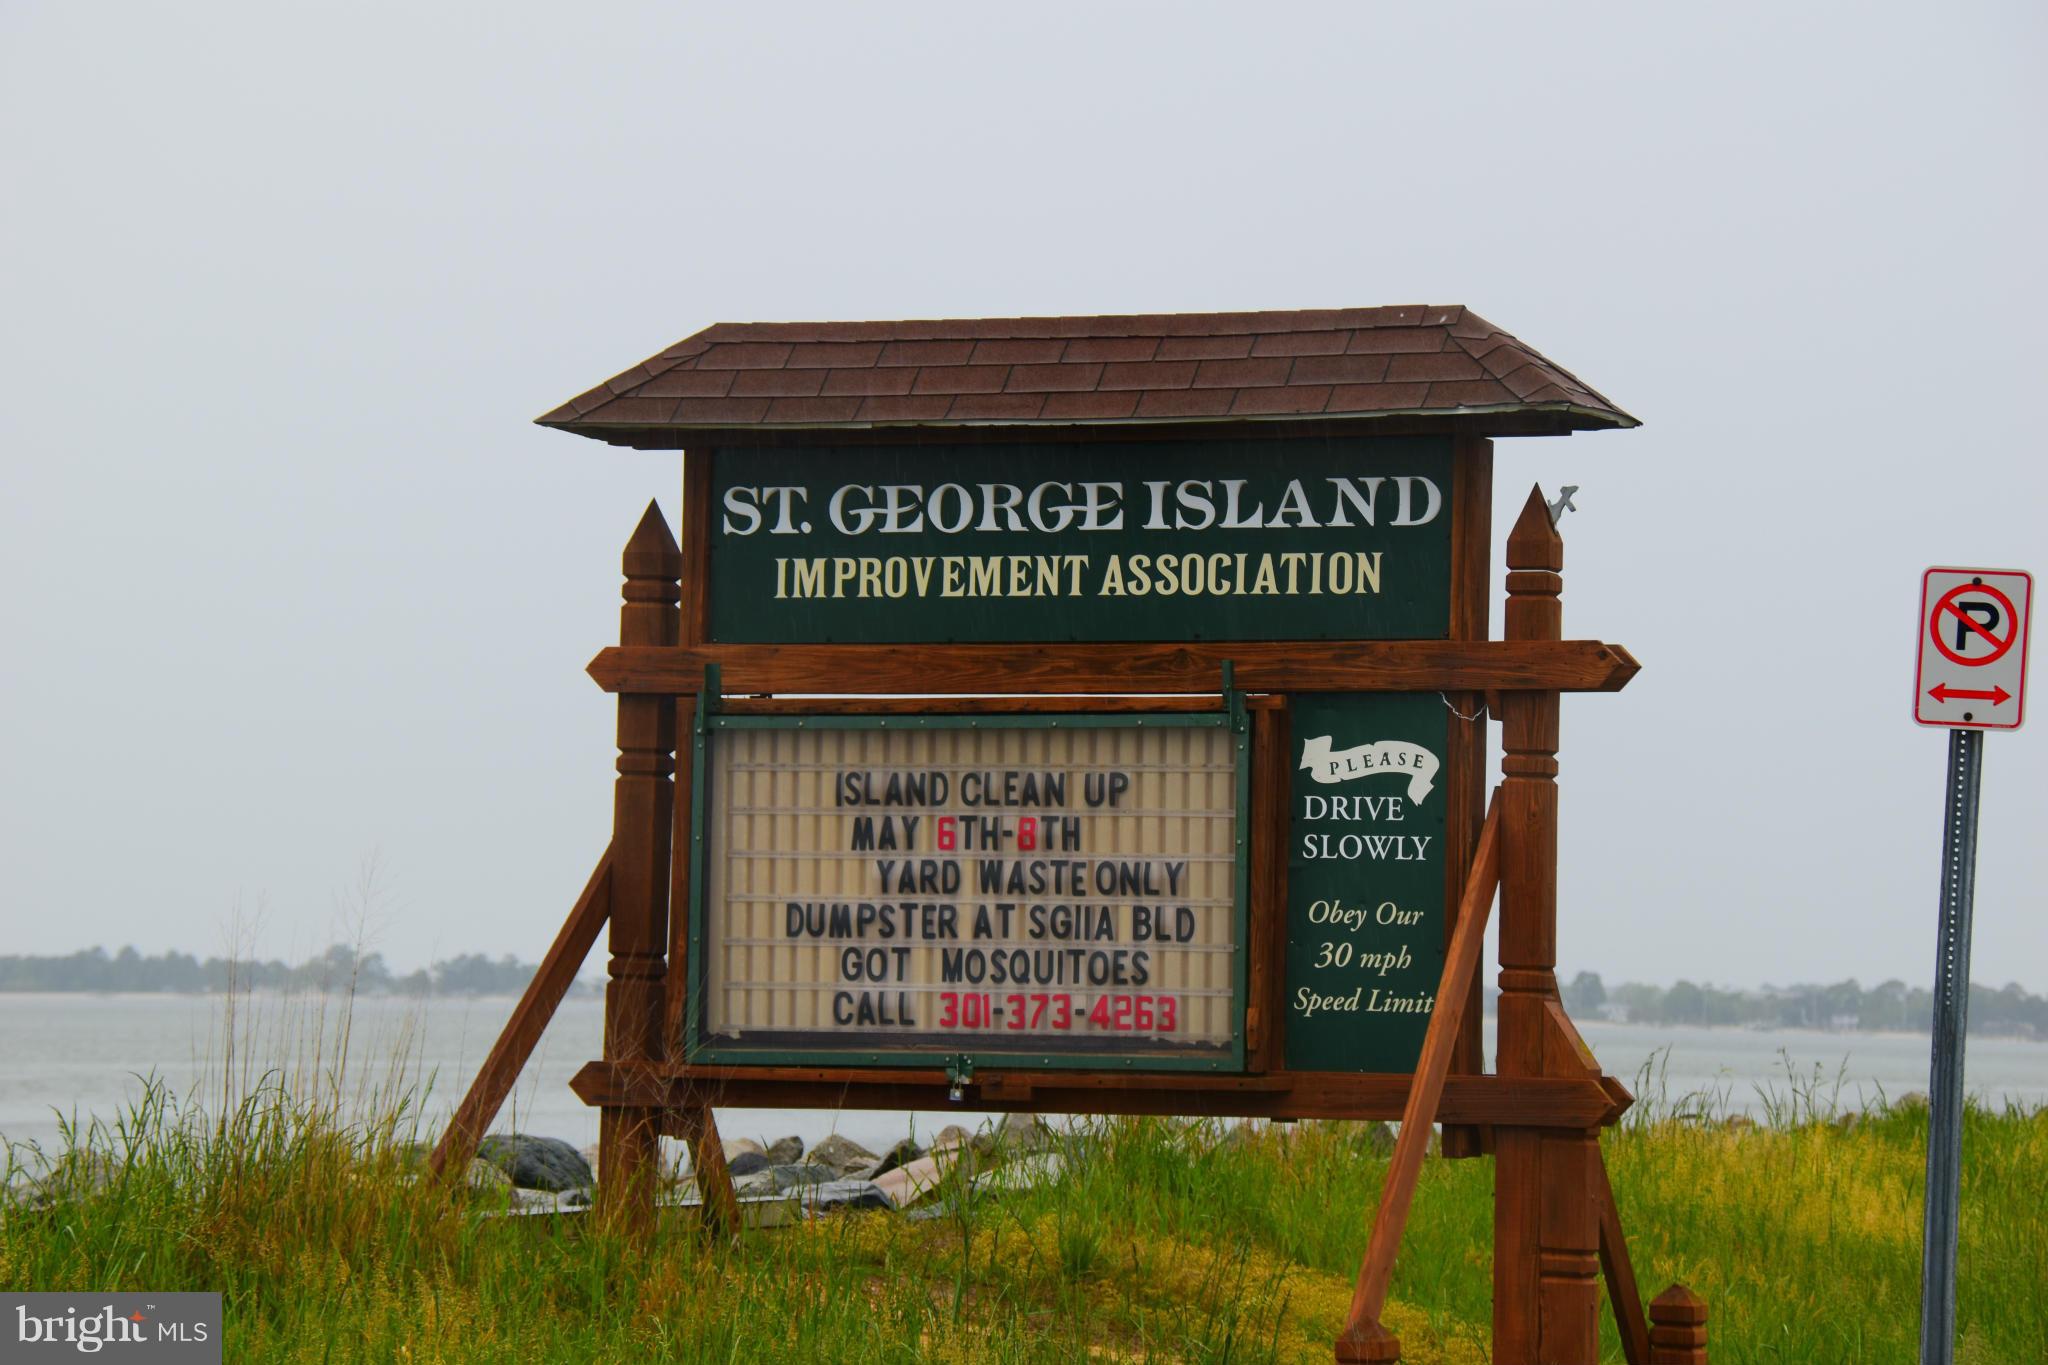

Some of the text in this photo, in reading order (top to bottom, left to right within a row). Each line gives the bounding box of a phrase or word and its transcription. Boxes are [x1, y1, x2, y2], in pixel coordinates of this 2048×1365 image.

[723, 475, 1443, 536] ST. GEORGE ISLAND
[774, 551, 1384, 601] IMPROVEMENT ASSOCIATION
[1956, 601, 2000, 651] P
[1329, 751, 1424, 776] PLEASE
[835, 771, 1129, 807] ISLAND CLEAN UP
[1303, 795, 1405, 822] DRIVE
[851, 816, 1080, 851] MAY 6TH-8TH
[1302, 834, 1432, 861] SLOWLY
[876, 859, 1185, 896] YARD WASTE ONLY
[785, 903, 1196, 942] DUMPSTER AT SGIIA BLD
[1308, 899, 1424, 932] Obey Our
[840, 947, 1149, 986] GOT MOSQUITOES
[1314, 942, 1412, 976] 30 mph
[833, 991, 1177, 1032] CALL 301-373-4263
[1294, 987, 1434, 1018] Speed Limit
